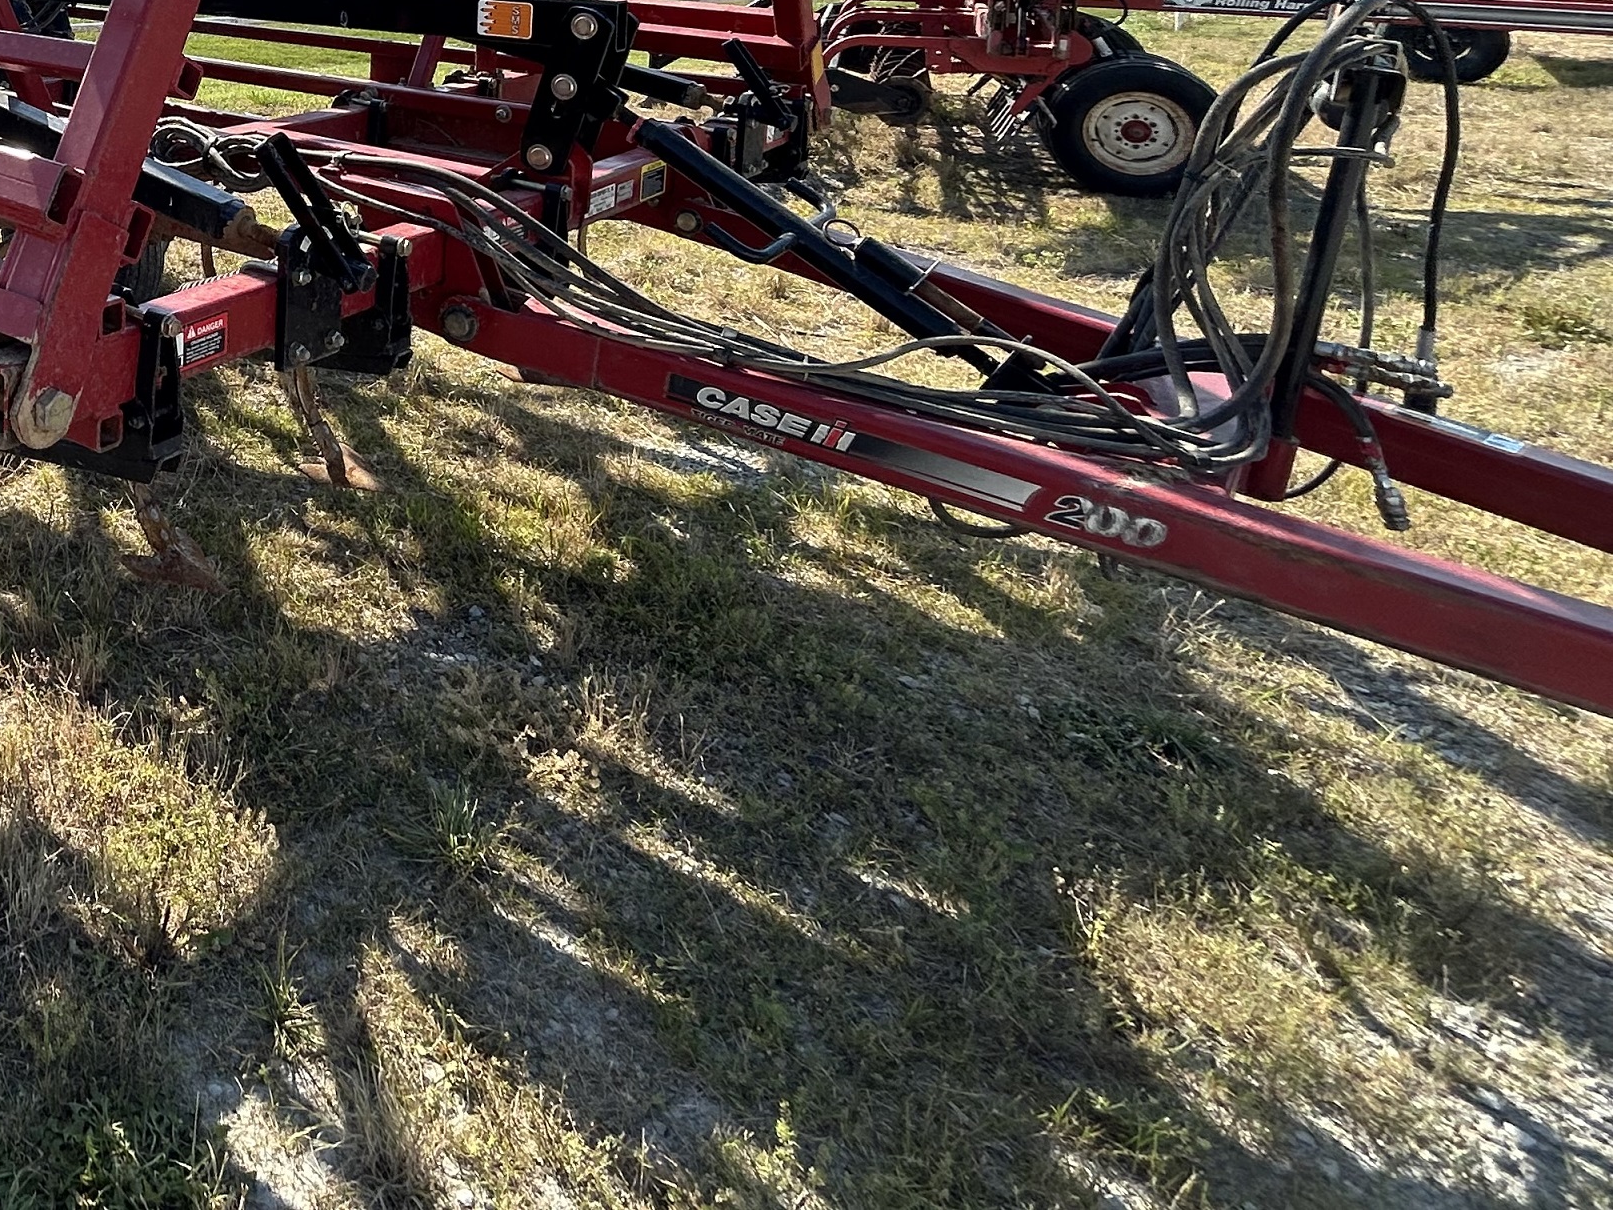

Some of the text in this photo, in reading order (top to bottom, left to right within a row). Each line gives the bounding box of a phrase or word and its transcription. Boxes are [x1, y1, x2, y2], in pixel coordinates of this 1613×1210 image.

[511, 5, 521, 35] SMS
[196, 318, 224, 336] DANGER
[696, 386, 813, 439] CASE
[1043, 494, 1168, 548] 200
